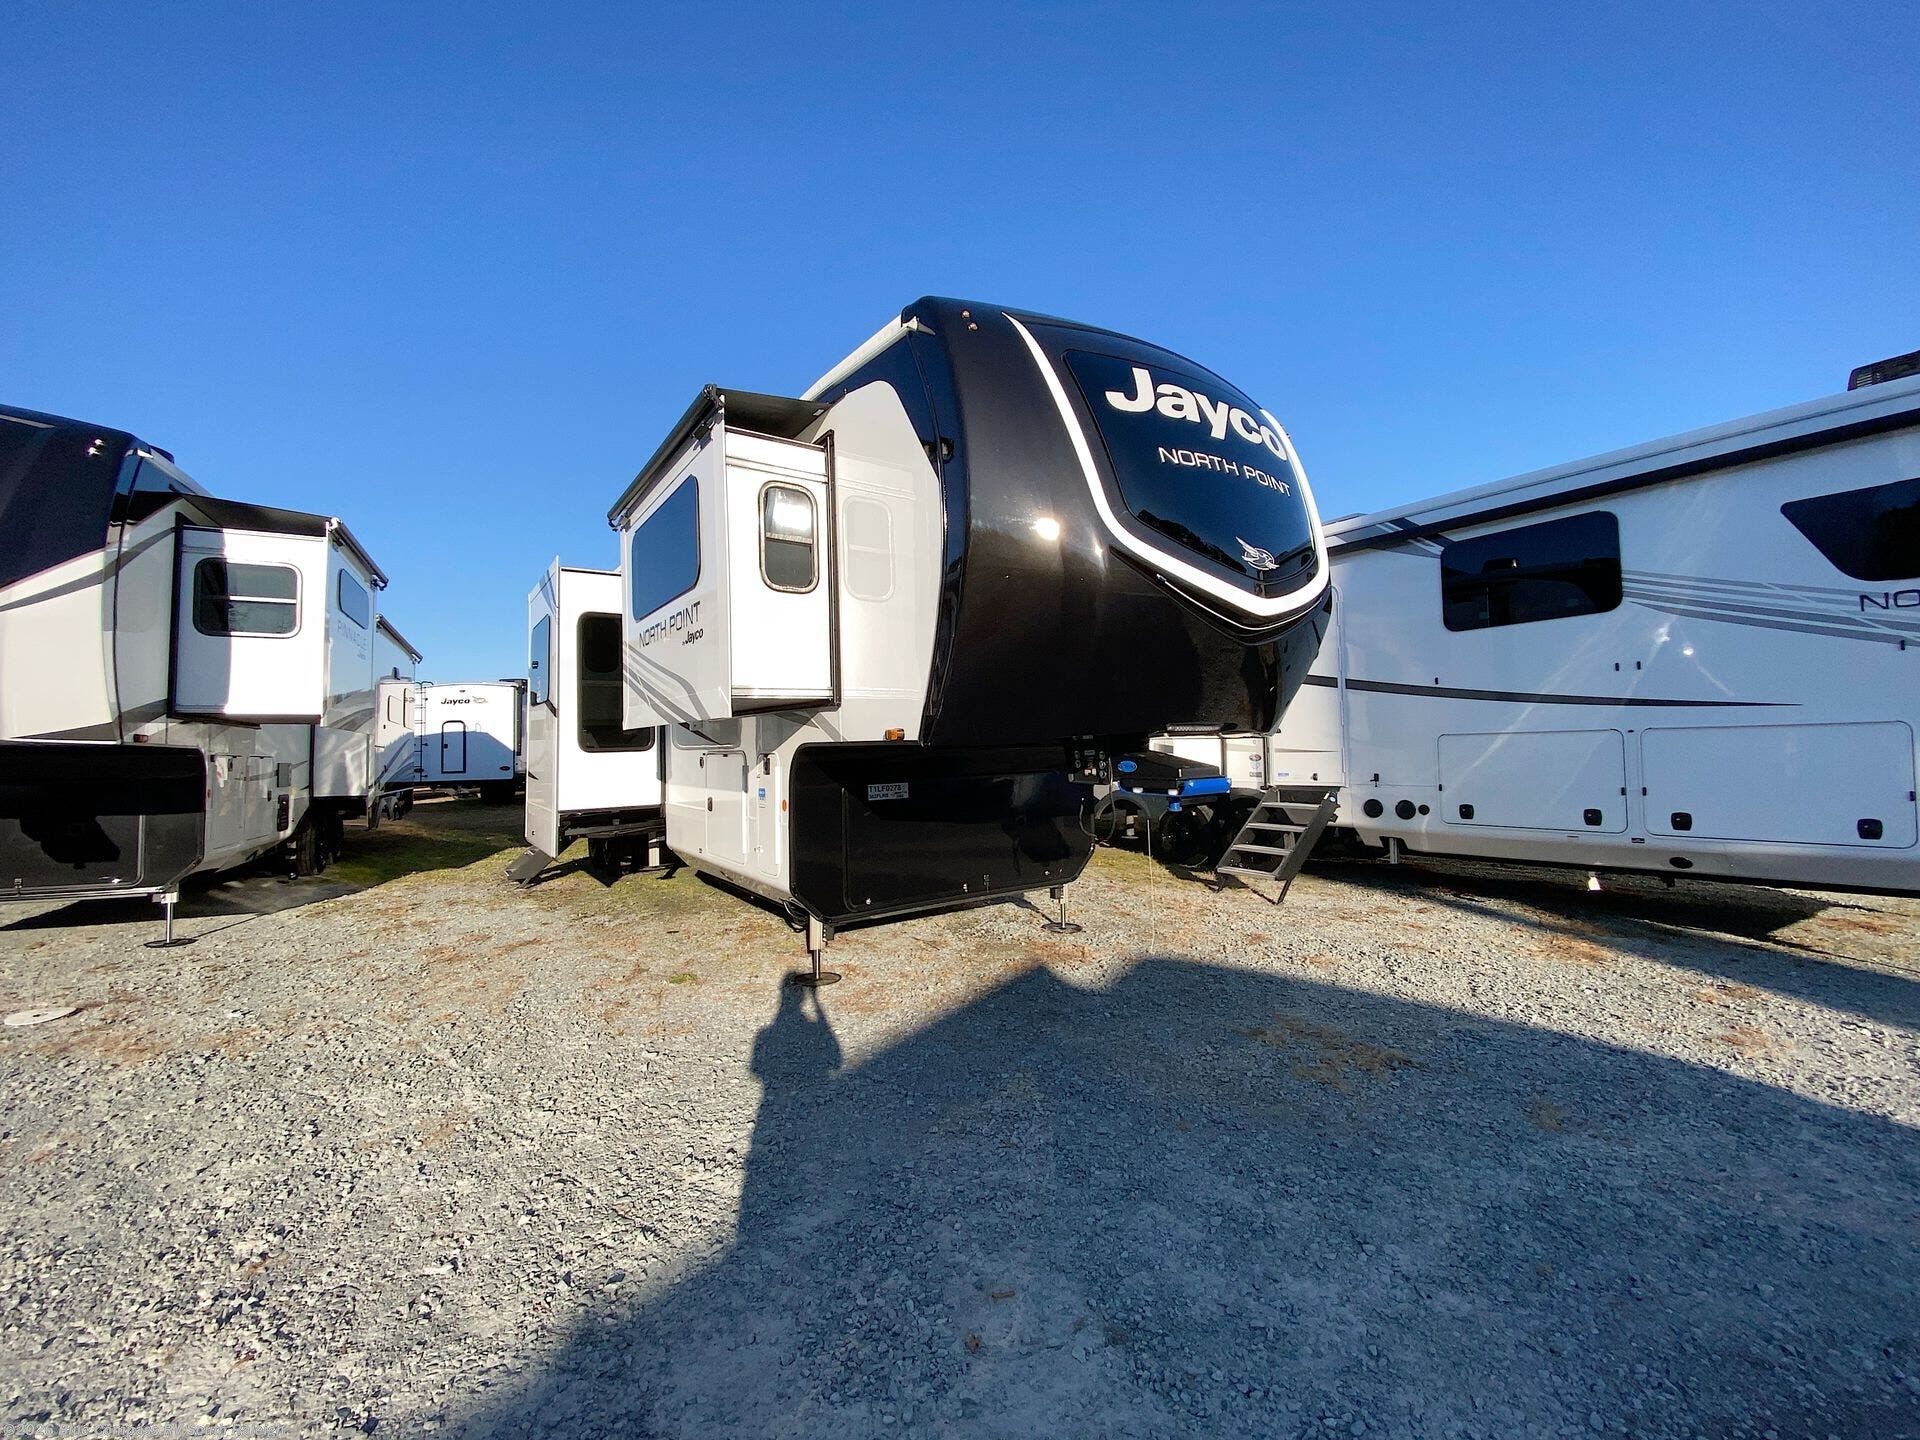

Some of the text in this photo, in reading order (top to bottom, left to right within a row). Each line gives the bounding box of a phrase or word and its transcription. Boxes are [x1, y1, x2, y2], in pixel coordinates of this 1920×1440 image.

[1105, 367, 1288, 461] Jayco
[1158, 447, 1291, 497] NORTH POINT
[639, 600, 701, 647] NORTH POINT
[685, 628, 703, 645] Jayco
[440, 697, 471, 706] Jayco
